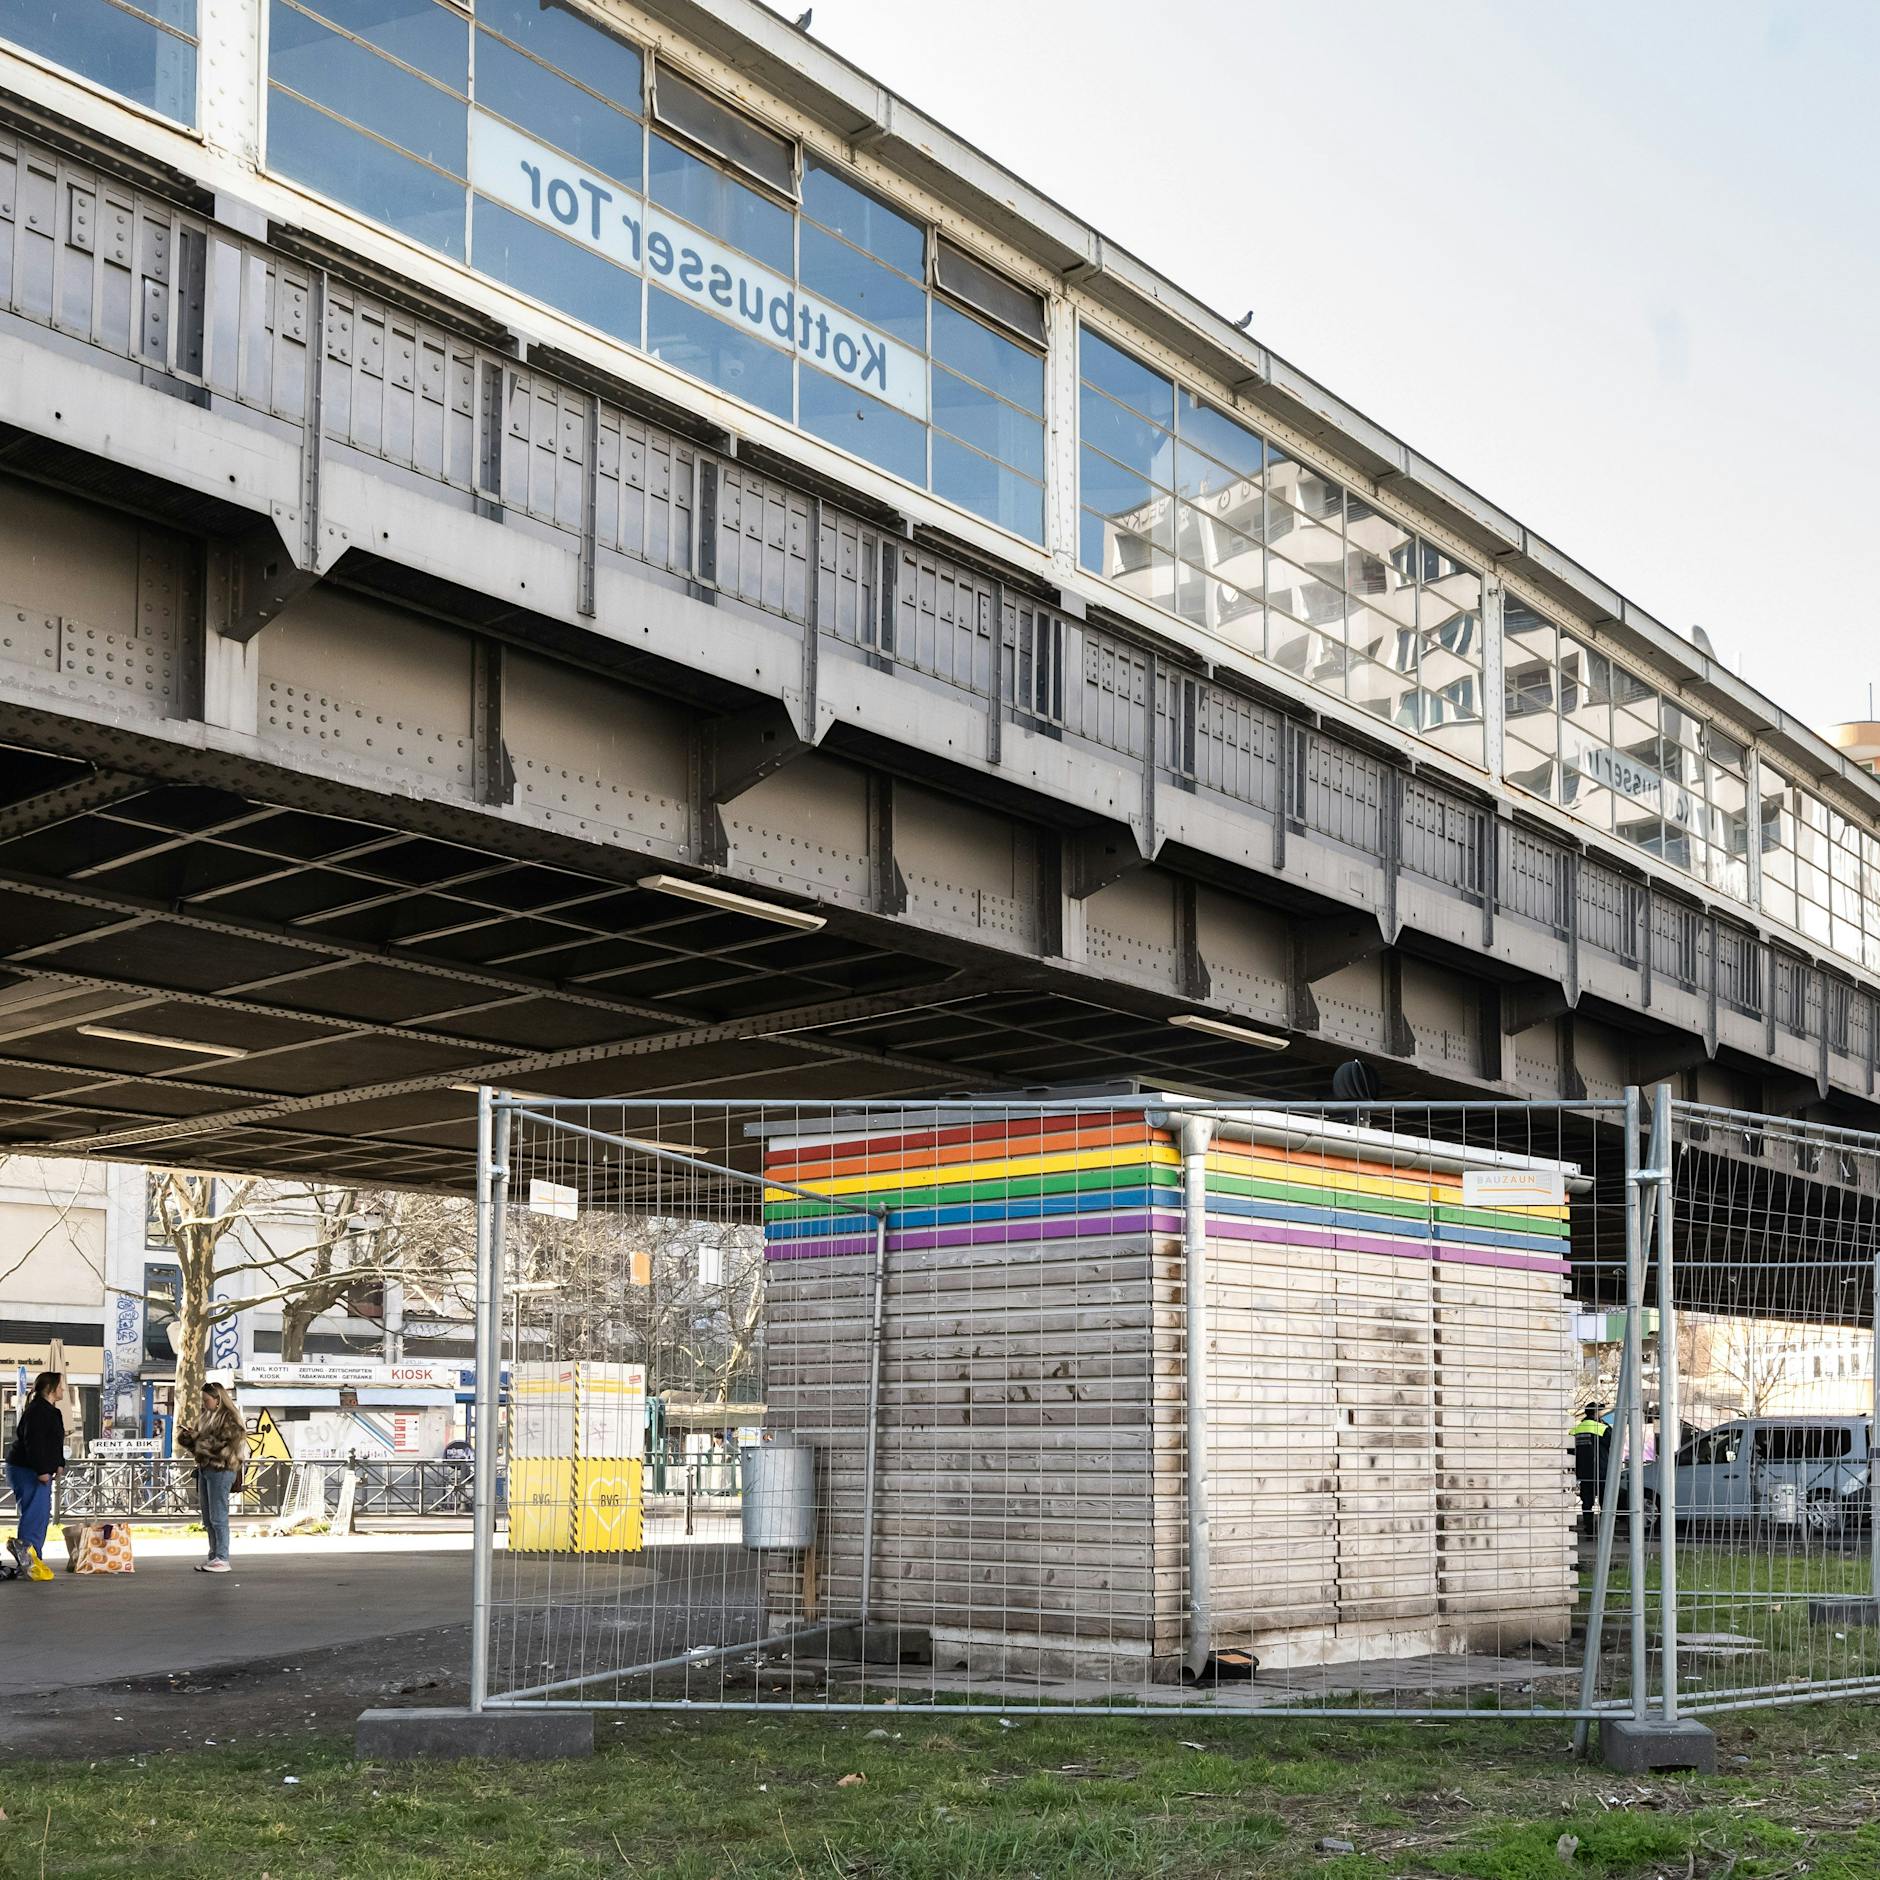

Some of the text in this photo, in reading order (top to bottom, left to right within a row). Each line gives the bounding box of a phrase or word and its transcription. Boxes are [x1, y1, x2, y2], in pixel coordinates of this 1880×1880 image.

[1476, 1175, 1536, 1185] BAUZAUN
[391, 1369, 433, 1380] KIOSK
[532, 1493, 551, 1505] BVG
[600, 1494, 620, 1507] BVG
